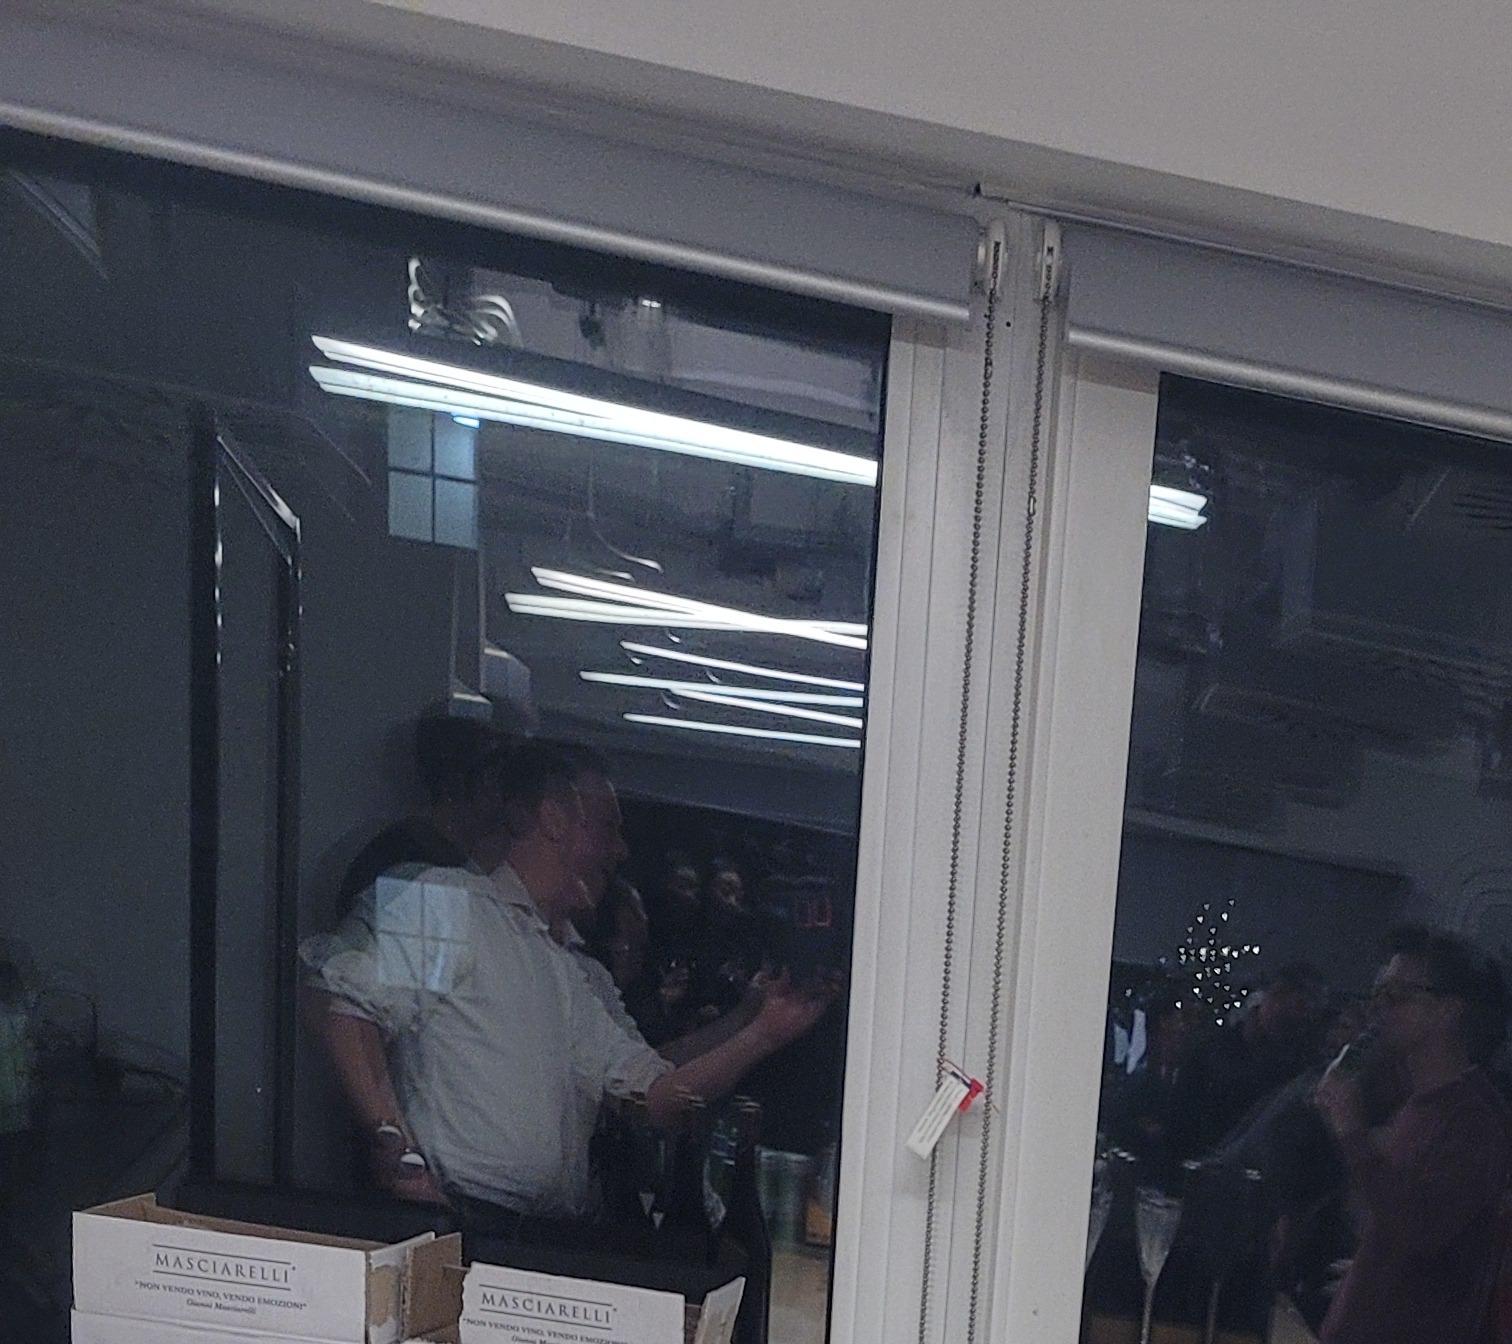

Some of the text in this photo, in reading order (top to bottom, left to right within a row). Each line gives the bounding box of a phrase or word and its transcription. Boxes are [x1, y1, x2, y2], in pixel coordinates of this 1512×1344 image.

[155, 1253, 290, 1284] MASCIARELLI
[162, 1282, 194, 1296] VENDO
[222, 1291, 256, 1304] VENDO
[480, 1292, 611, 1324] MASCIARELLI
[488, 1319, 520, 1333] VENDO
[547, 1329, 579, 1341] VENDO
